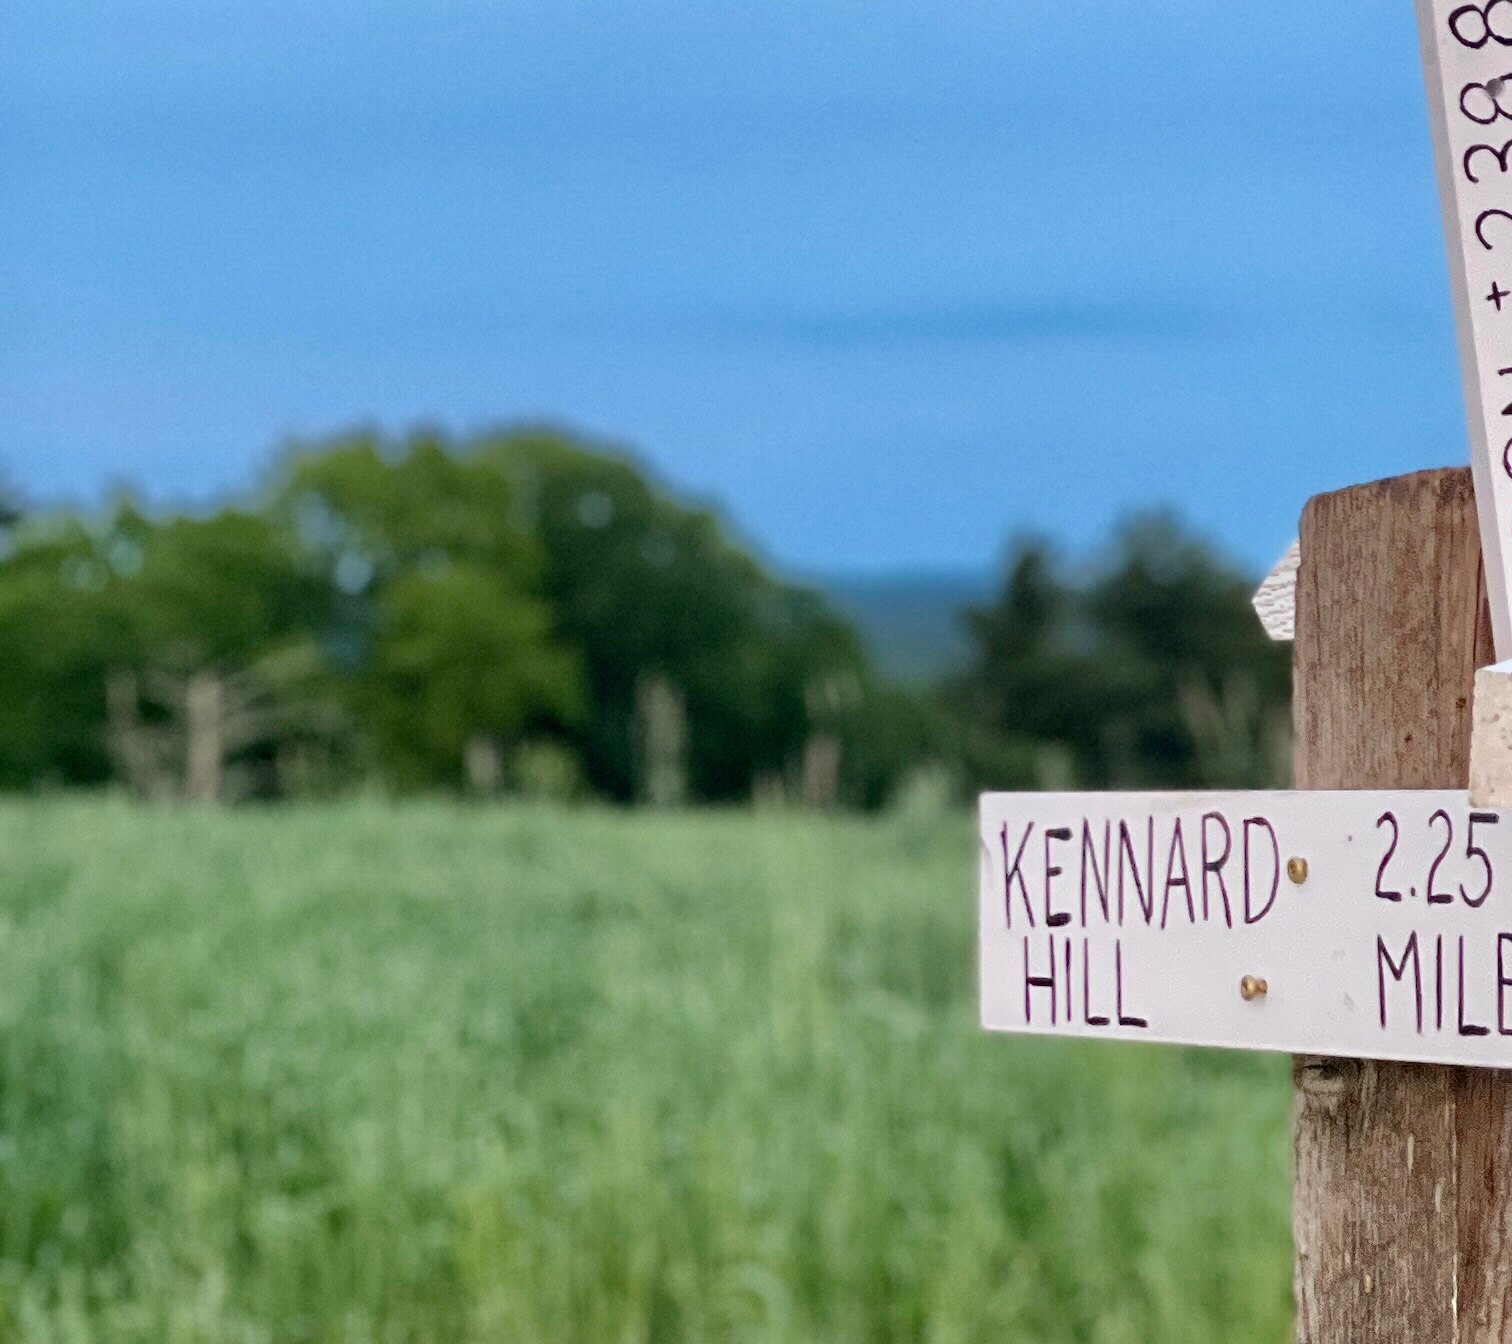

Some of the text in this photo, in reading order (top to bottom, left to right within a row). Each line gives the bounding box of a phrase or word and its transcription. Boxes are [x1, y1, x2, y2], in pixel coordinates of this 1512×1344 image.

[1000, 808, 1501, 930] KENNARD 2.25
[1022, 935, 1150, 1029] HILL
